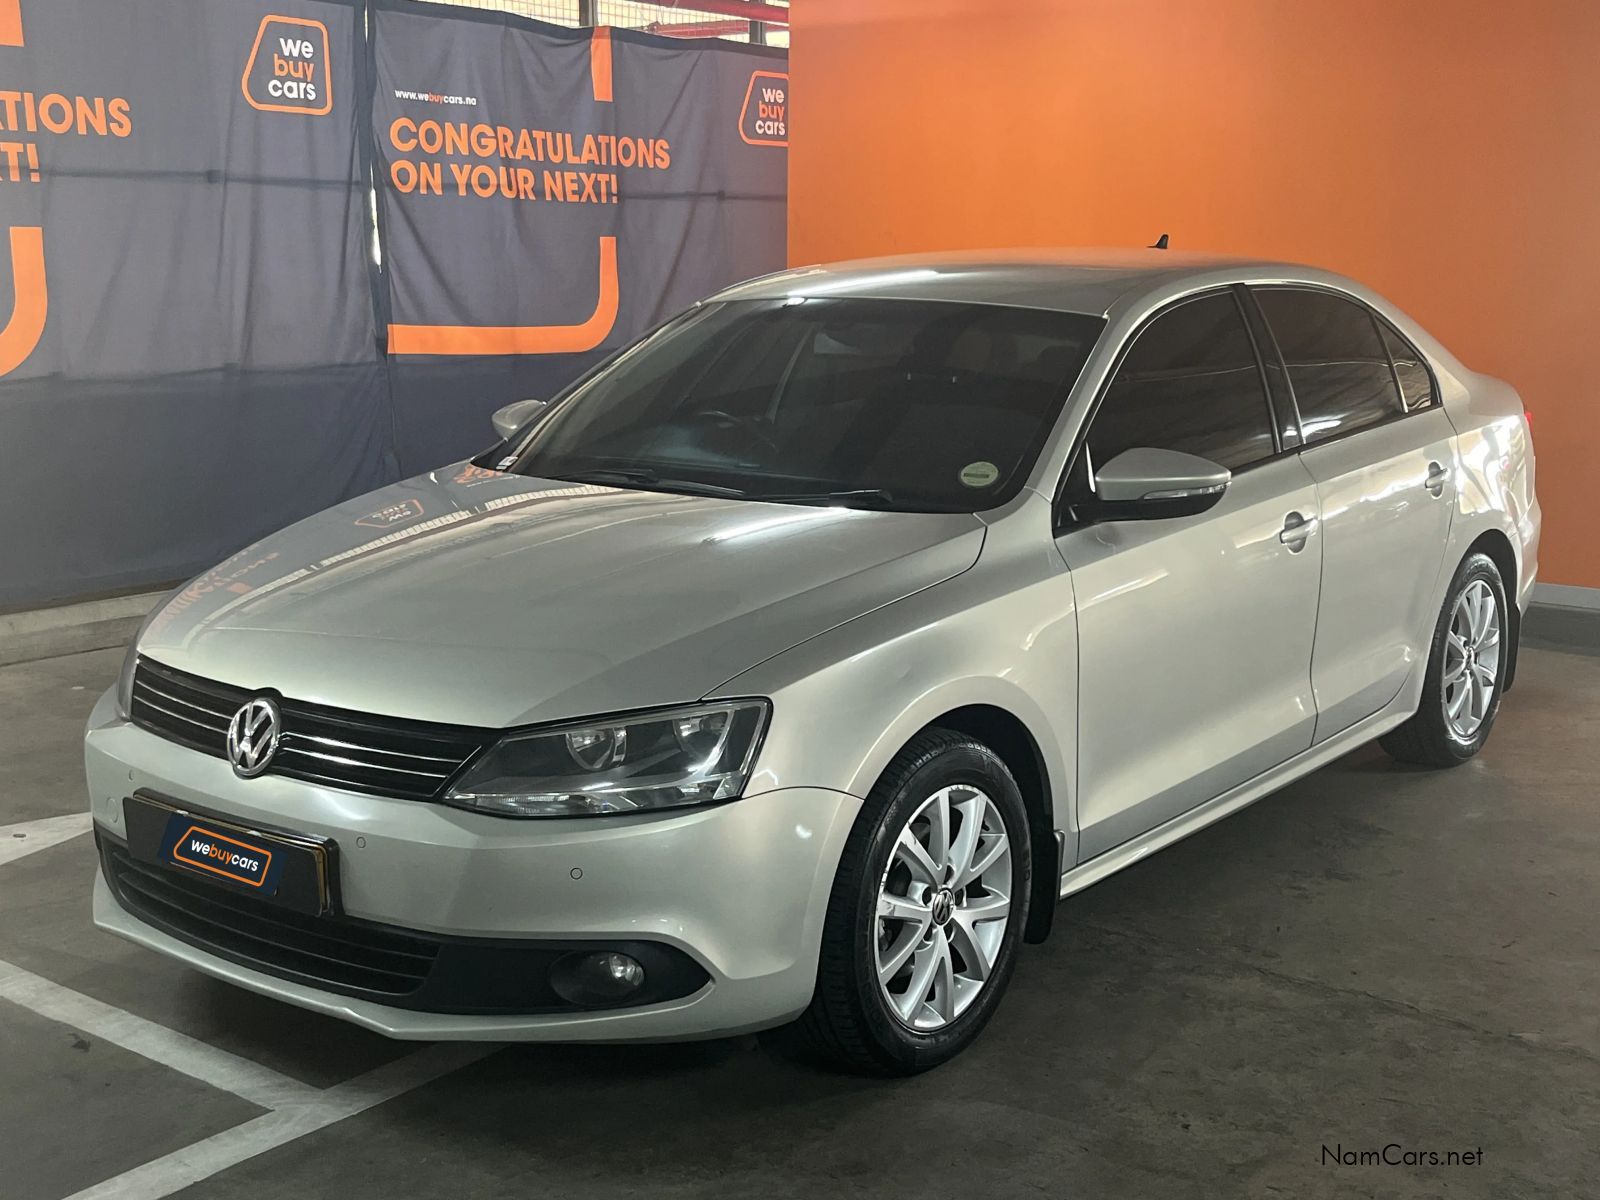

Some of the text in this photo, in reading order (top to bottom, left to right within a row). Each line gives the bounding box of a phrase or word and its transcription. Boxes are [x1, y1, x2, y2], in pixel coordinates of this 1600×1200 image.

[279, 37, 314, 59] we
[273, 53, 315, 82] buy
[268, 79, 316, 101] cars
[394, 89, 477, 106] www.webuycars.na
[762, 87, 785, 104] we
[0, 90, 132, 138] TIONS
[758, 100, 785, 121] buy
[755, 119, 786, 136] cars
[389, 116, 671, 169] CONGRATULATIONS
[0, 141, 41, 183] T!
[390, 159, 618, 205] ON YOUR NEXT!
